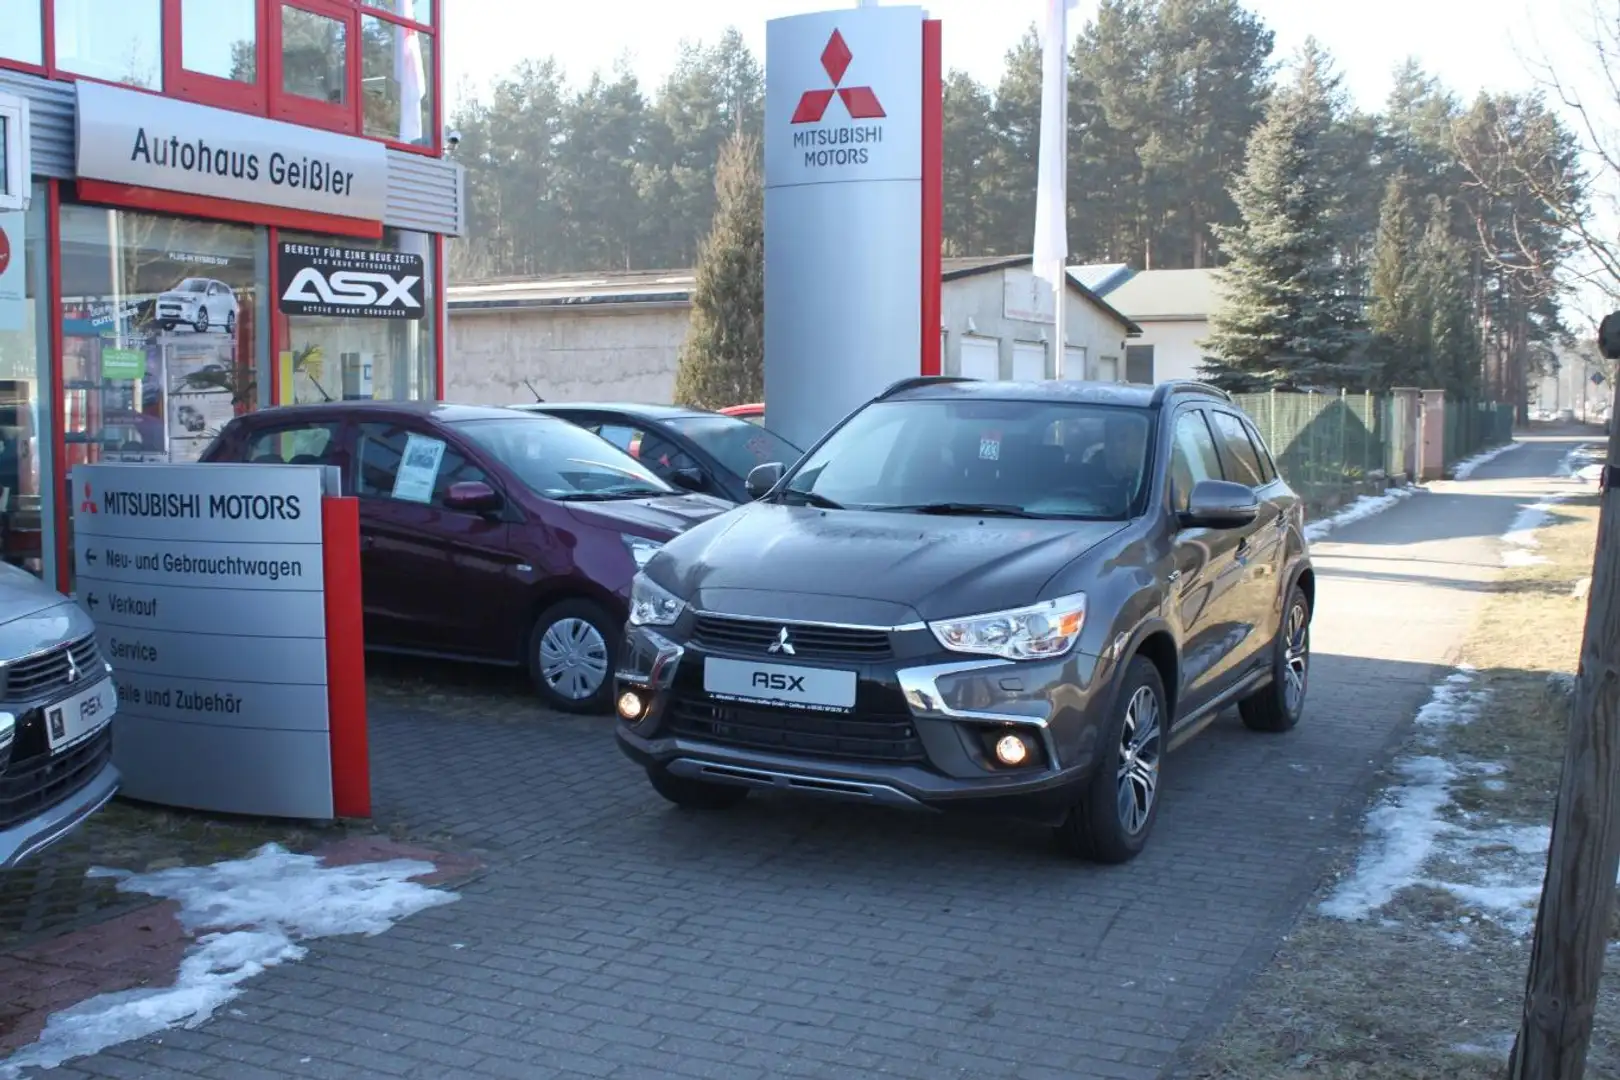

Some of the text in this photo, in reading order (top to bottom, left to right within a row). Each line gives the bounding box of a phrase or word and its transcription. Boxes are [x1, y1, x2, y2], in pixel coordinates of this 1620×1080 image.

[793, 126, 882, 148] MITSUBISHI
[131, 127, 354, 196] Autohaus Geißler
[804, 148, 869, 168] MOTORS
[284, 243, 321, 256] BEREIT
[323, 247, 341, 258] FÜR
[344, 250, 366, 260] EINE
[369, 252, 392, 263] NEUE
[281, 267, 422, 308] ASX
[104, 491, 301, 520] MITSUBISHI MOTORS
[106, 549, 302, 580] Neu- und Gebrauchtwagen
[108, 592, 157, 617] Verkauf
[110, 637, 157, 662] Service
[752, 671, 806, 693] ASX
[117, 683, 242, 713] eile und Zubehör
